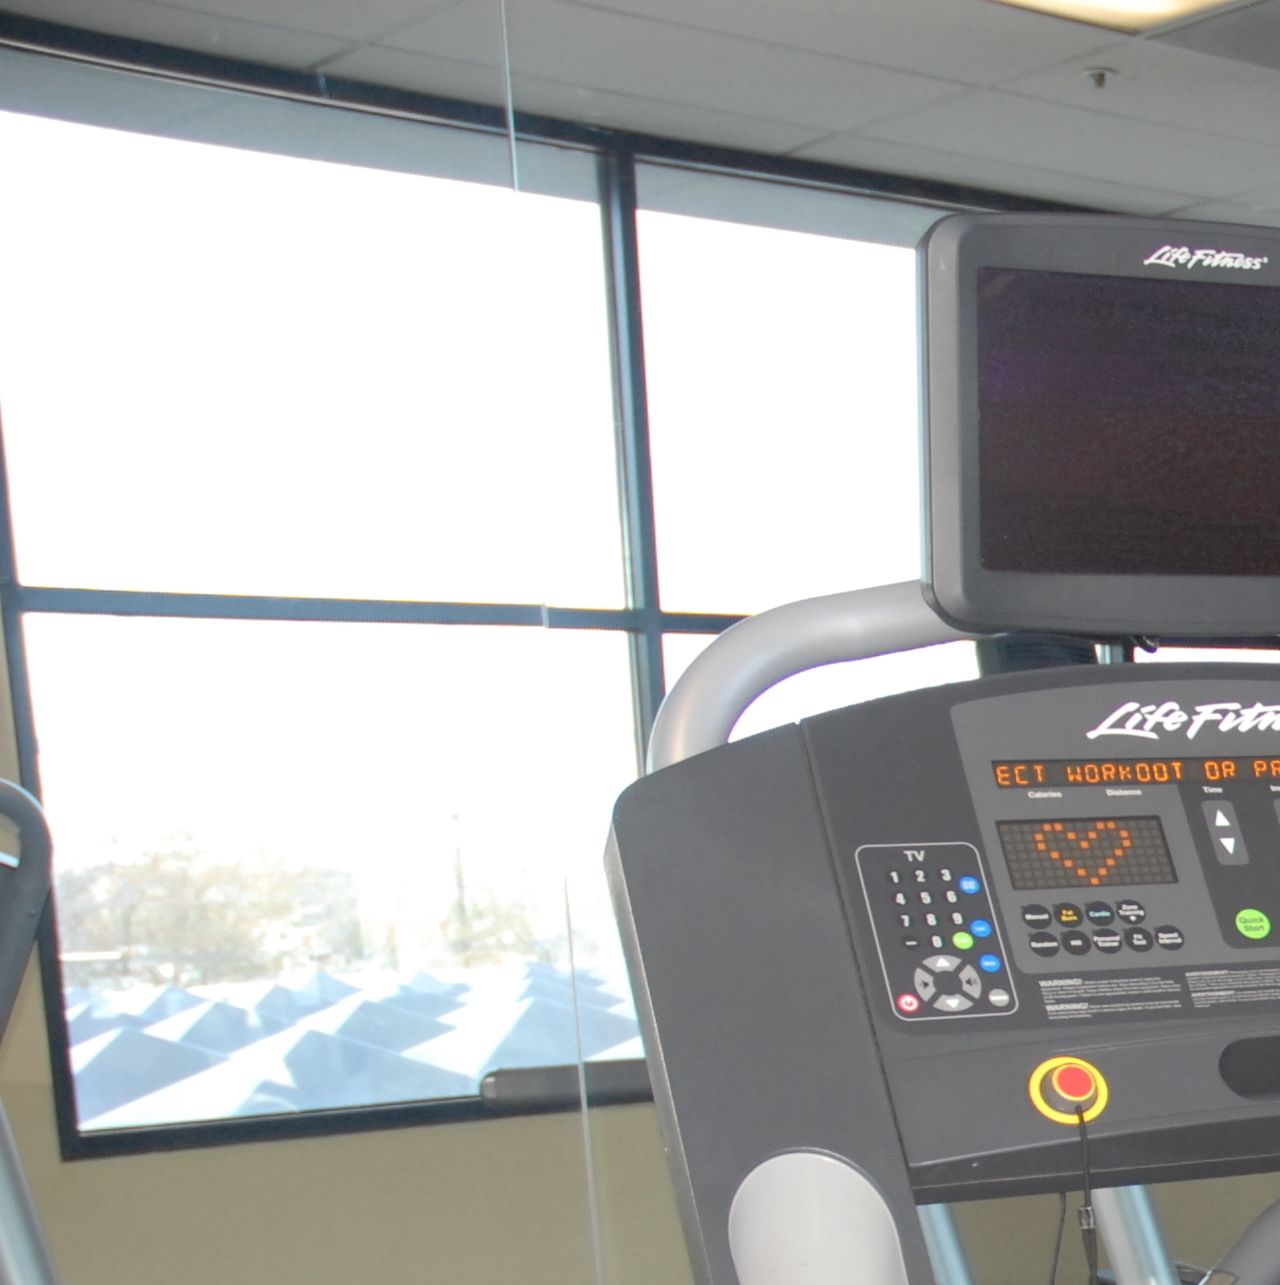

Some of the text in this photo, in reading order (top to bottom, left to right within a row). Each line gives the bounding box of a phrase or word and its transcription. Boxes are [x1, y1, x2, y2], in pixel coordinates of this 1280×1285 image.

[1143, 245, 1263, 270] Life Fitness
[1086, 701, 1188, 740] Life
[1204, 760, 1236, 780] OR
[1203, 786, 1223, 794] Time
[904, 850, 925, 862] TV
[890, 869, 952, 884] 1 2 3
[896, 891, 957, 905] 4 5 6
[901, 915, 910, 928] 7
[952, 912, 963, 925] 9
